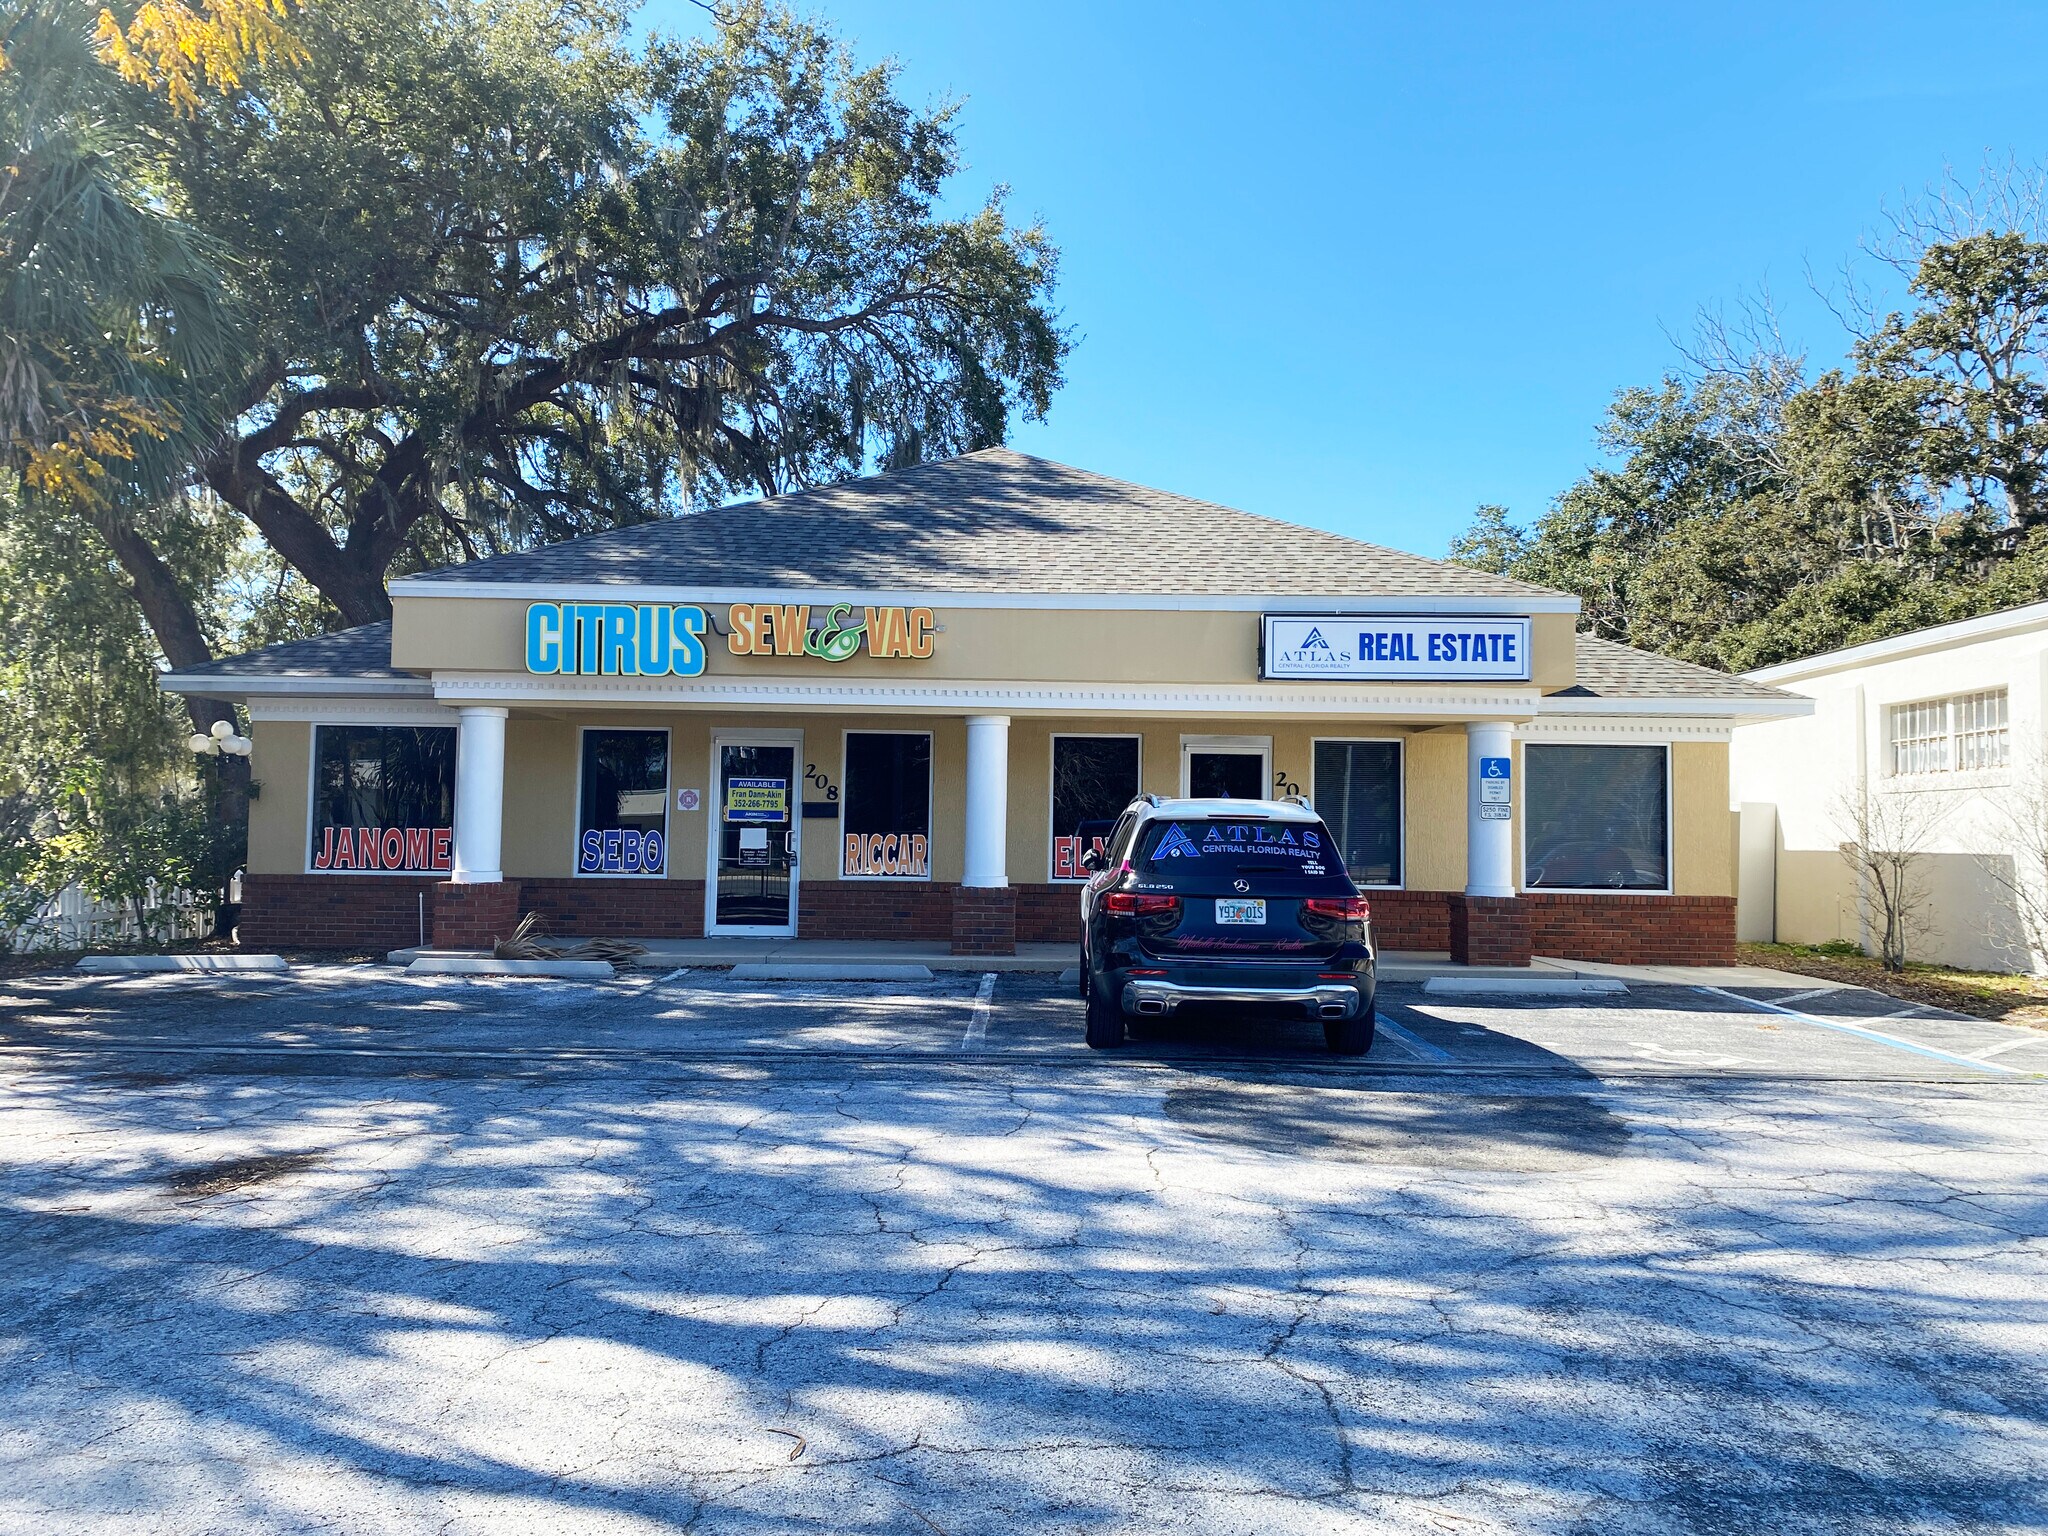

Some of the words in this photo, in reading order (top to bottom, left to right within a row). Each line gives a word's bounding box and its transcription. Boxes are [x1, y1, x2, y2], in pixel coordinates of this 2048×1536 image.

[525, 602, 707, 677] CITRUS
[728, 603, 809, 656] SEW
[864, 605, 936, 660] VAC
[1359, 632, 1419, 661] REAL
[1428, 633, 1516, 662] ESTATE
[1280, 651, 1351, 662] ATLAS
[731, 789, 747, 798] Fran
[804, 764, 838, 801] 208
[1275, 771, 1308, 797] 20
[734, 799, 779, 808] 352-266-7795
[315, 827, 452, 870] JANOME
[1203, 825, 1321, 848] ATLAS
[581, 829, 664, 872] SEBO
[845, 833, 928, 875] RICCAR
[1202, 844, 1246, 853] CENTRAL
[1247, 845, 1287, 855] FLORIDA
[1288, 848, 1321, 860] REALTY
[1218, 905, 1236, 919] Y93
